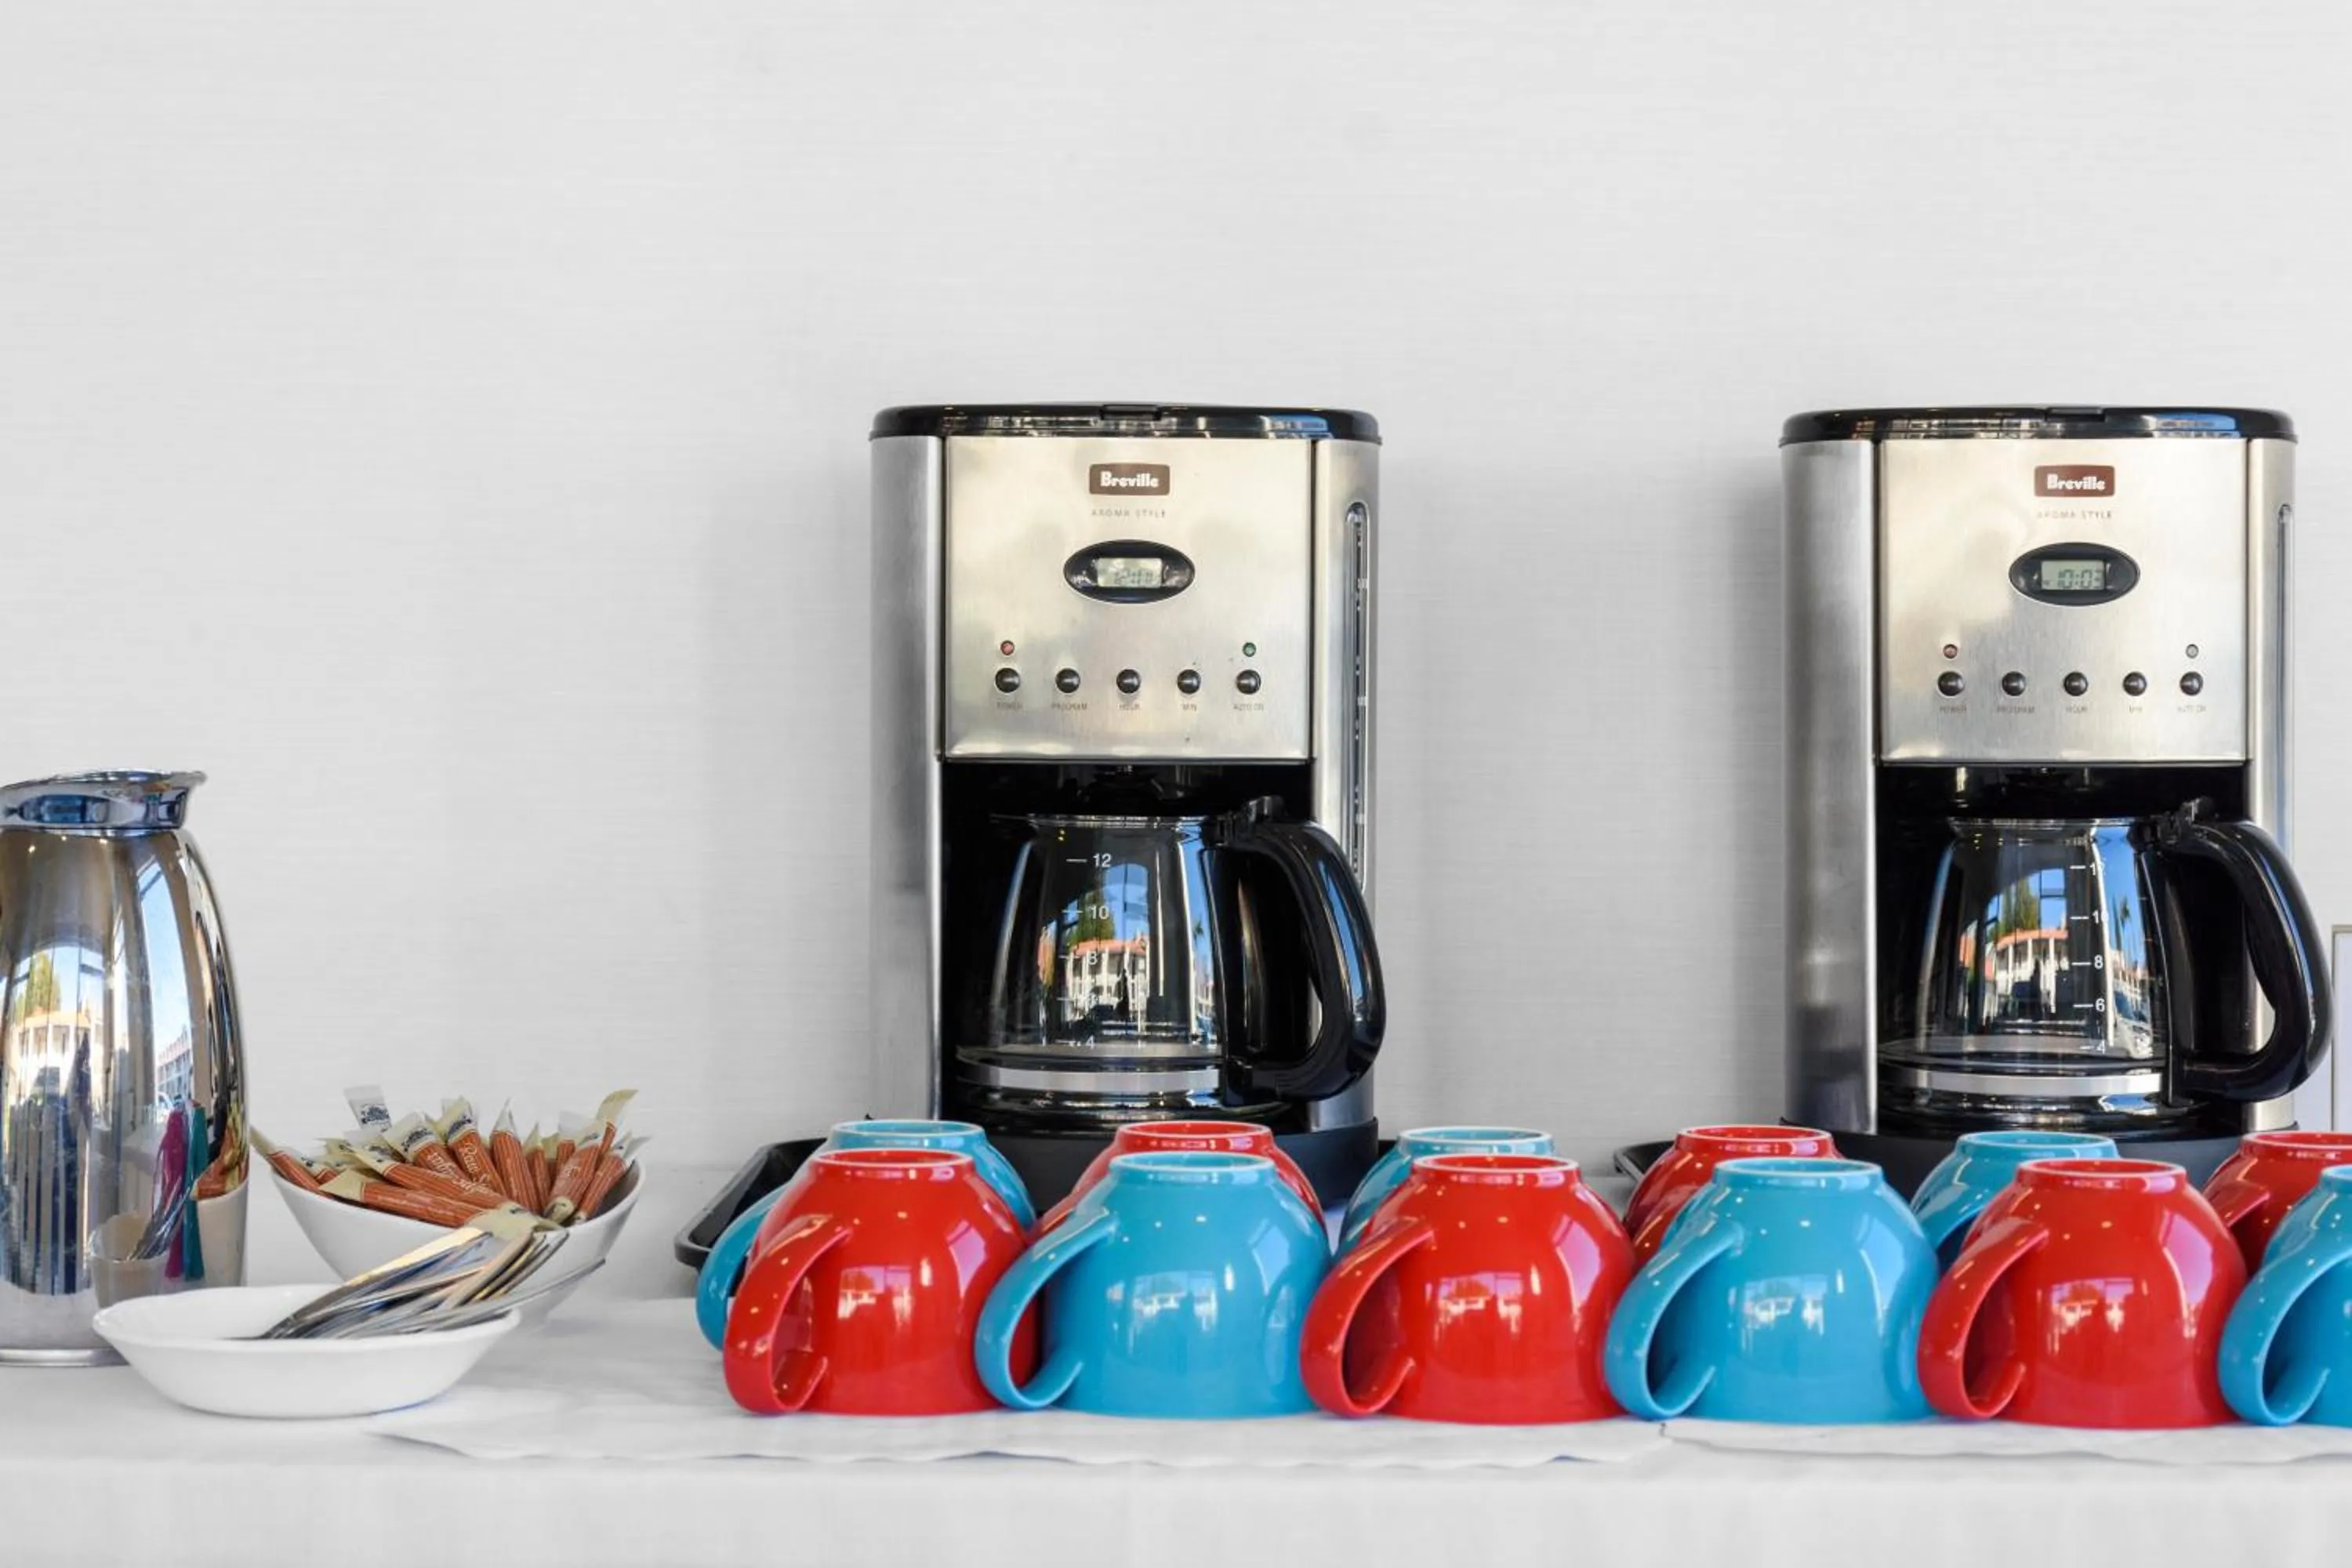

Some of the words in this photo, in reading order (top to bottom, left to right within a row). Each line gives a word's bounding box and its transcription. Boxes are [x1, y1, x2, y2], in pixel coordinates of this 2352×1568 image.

[1100, 471, 1160, 488] Breville
[2047, 474, 2106, 491] Breville
[1093, 852, 1112, 868] 12
[1091, 906, 1109, 920] 10
[2094, 954, 2103, 970] 8
[2095, 998, 2106, 1013] 6
[1086, 1034, 1095, 1050] 4
[2096, 1041, 2106, 1054] 4
